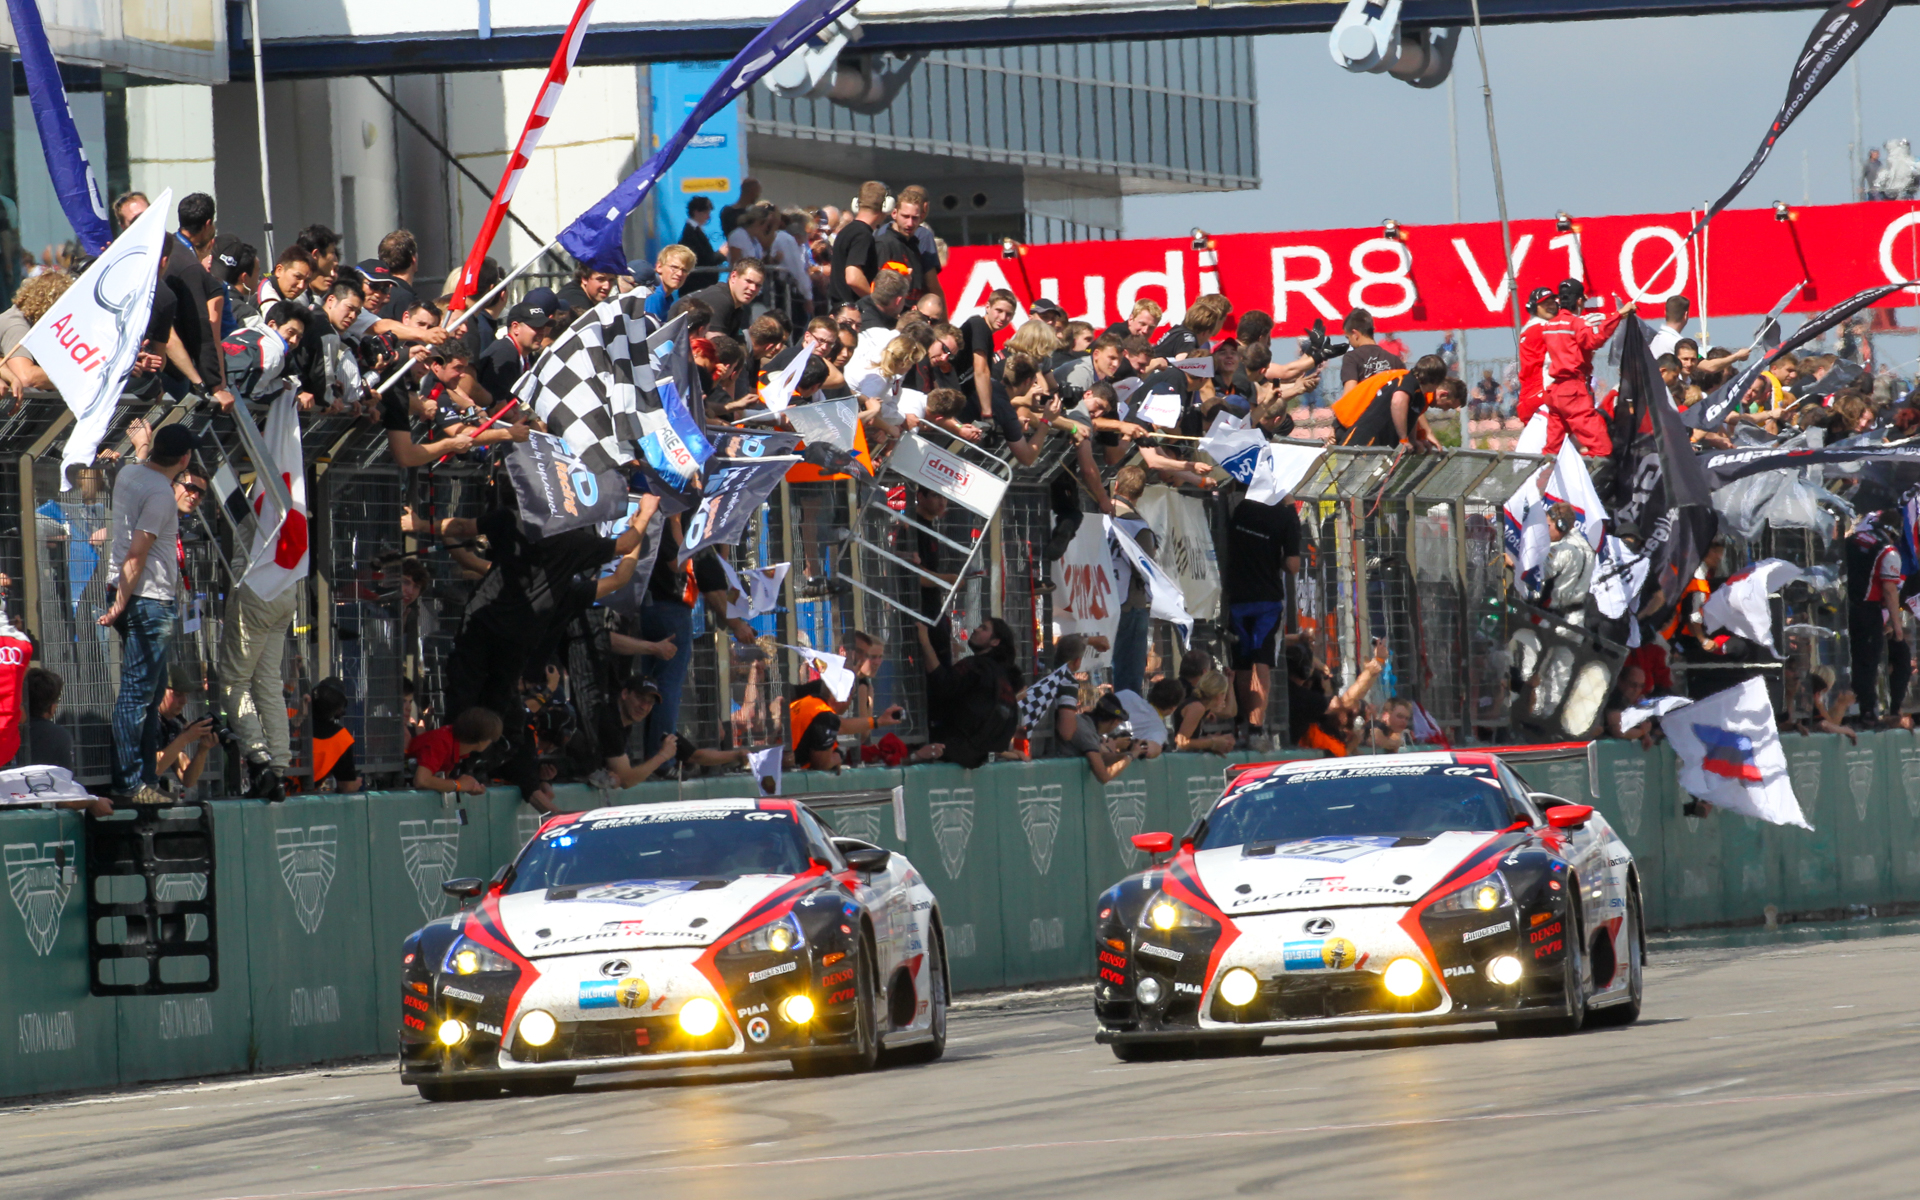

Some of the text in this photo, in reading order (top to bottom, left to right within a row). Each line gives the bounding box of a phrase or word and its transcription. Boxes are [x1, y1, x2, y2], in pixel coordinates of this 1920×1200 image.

[948, 250, 1222, 332] Audi
[1271, 238, 1418, 324] R8
[1451, 226, 1690, 313] V10
[50, 313, 107, 373] Audi
[672, 447, 691, 466] AG
[928, 458, 970, 486] dmsj
[554, 461, 578, 517] Racing
[1288, 765, 1431, 782] GRAN TURISMO
[592, 810, 732, 828] GRAN TURISMO
[1283, 843, 1363, 856] 87
[1231, 886, 1411, 907] GAZOO Racing
[534, 929, 708, 949] GAZOO Racing
[1464, 922, 1510, 942] BRIDGESTONE
[1530, 922, 1562, 944] DENSO
[1140, 943, 1184, 961] BRIDGESTONE
[1284, 949, 1321, 961] BILSTEIN
[1534, 939, 1563, 960] KYB
[1100, 951, 1127, 969] DENSO
[822, 968, 854, 987] DENSO
[1100, 967, 1125, 986] KYB
[1443, 965, 1475, 979] PIAA
[828, 988, 855, 1004] KYB
[1174, 982, 1203, 995] PIAA
[403, 994, 429, 1013] DENSO
[737, 1003, 769, 1018] PIAA
[475, 1021, 502, 1036] PIAA
